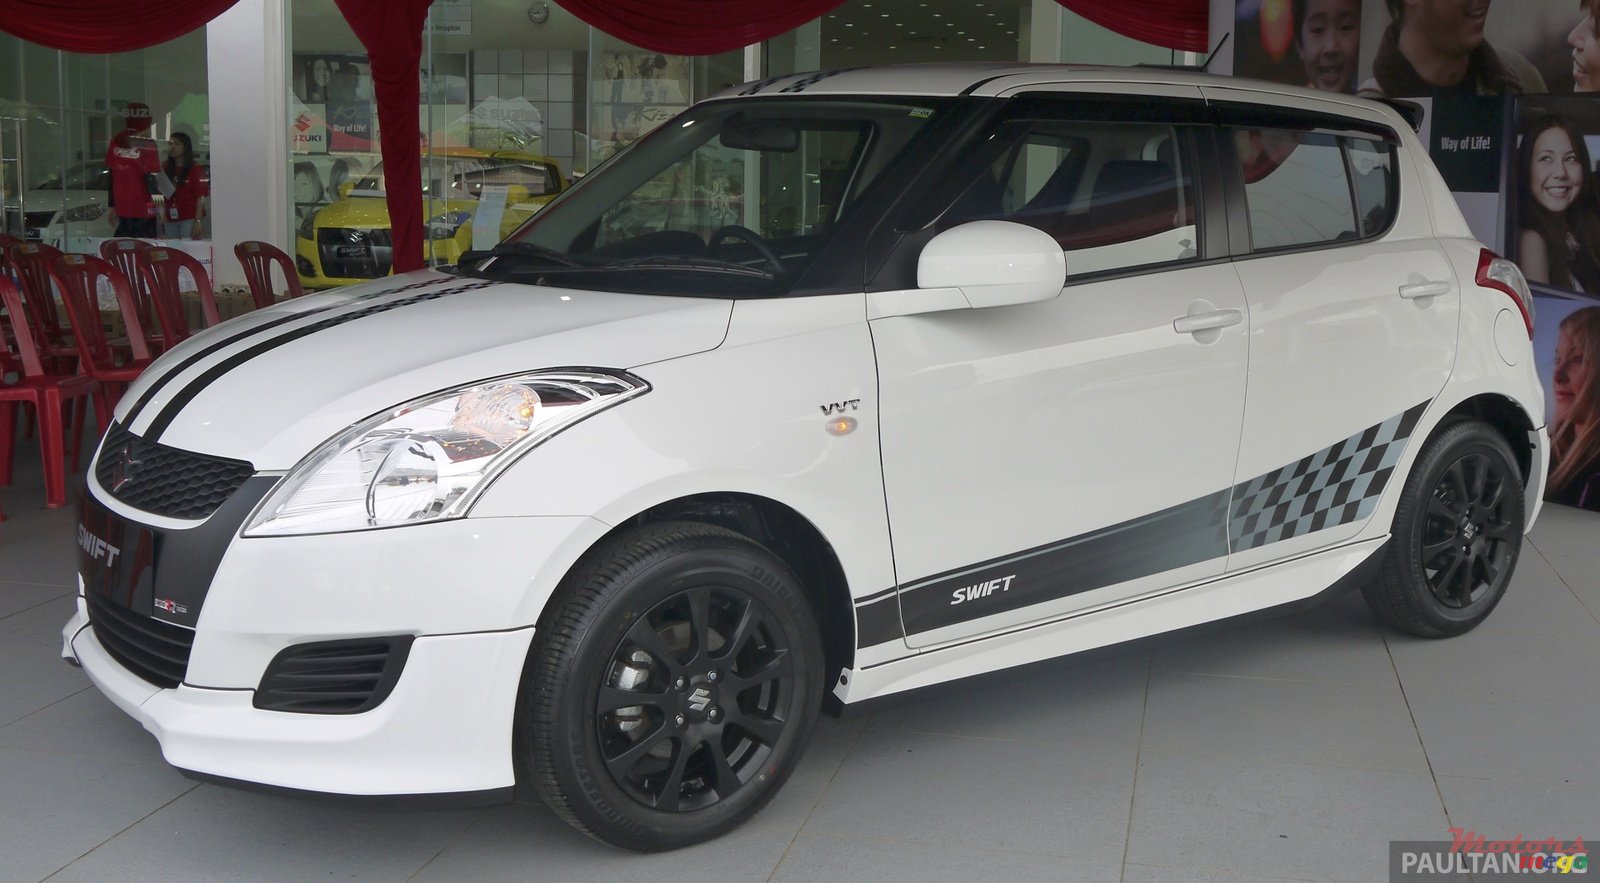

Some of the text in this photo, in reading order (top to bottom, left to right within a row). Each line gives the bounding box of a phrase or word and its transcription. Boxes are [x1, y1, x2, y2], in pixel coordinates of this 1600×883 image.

[333, 123, 367, 134] Way of Life!
[1441, 136, 1491, 152] Way of Life!
[820, 398, 861, 416] VVT
[78, 523, 120, 567] SWIFT
[950, 574, 1017, 605] SWIFT
